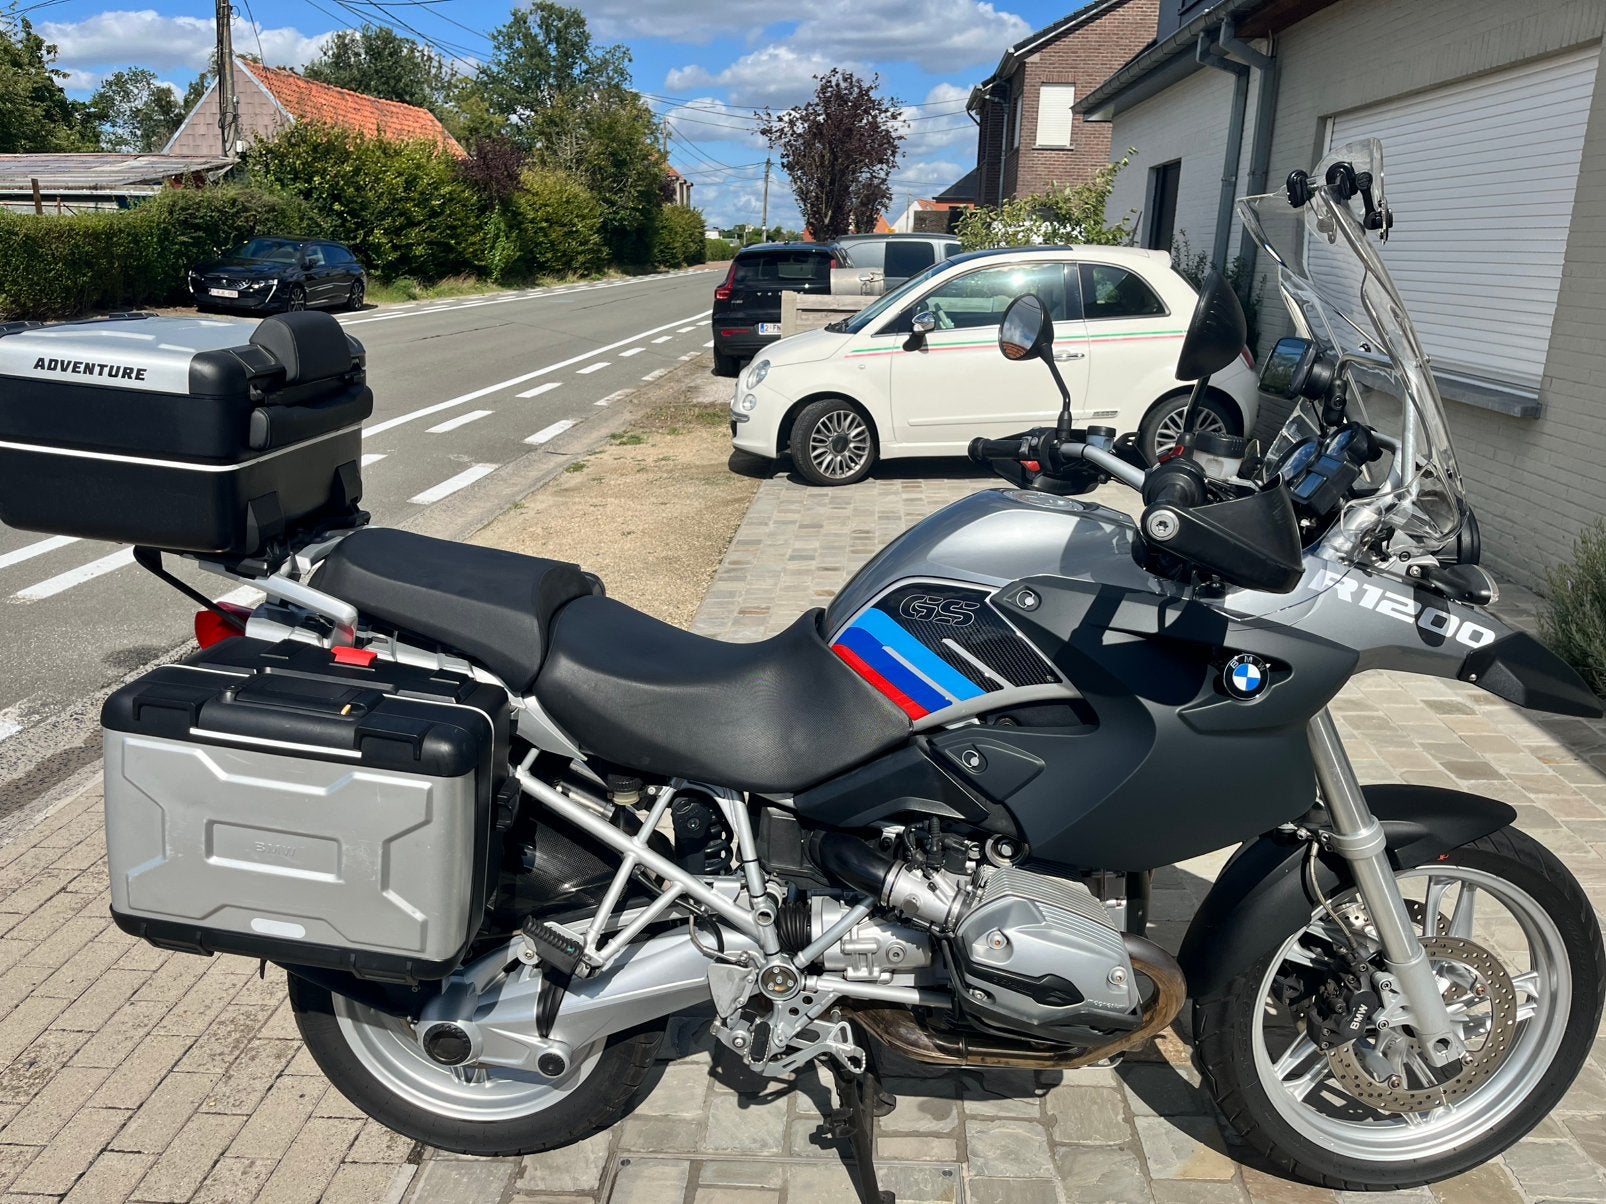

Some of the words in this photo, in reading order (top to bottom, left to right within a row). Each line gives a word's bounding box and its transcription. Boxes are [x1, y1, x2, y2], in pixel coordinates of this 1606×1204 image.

[33, 357, 148, 381] ADVENTURE
[900, 594, 980, 627] GS
[1308, 568, 1496, 649] R1200
[1230, 655, 1266, 671] BMW
[254, 840, 297, 857] BMW
[1350, 1003, 1368, 1030] BMW
